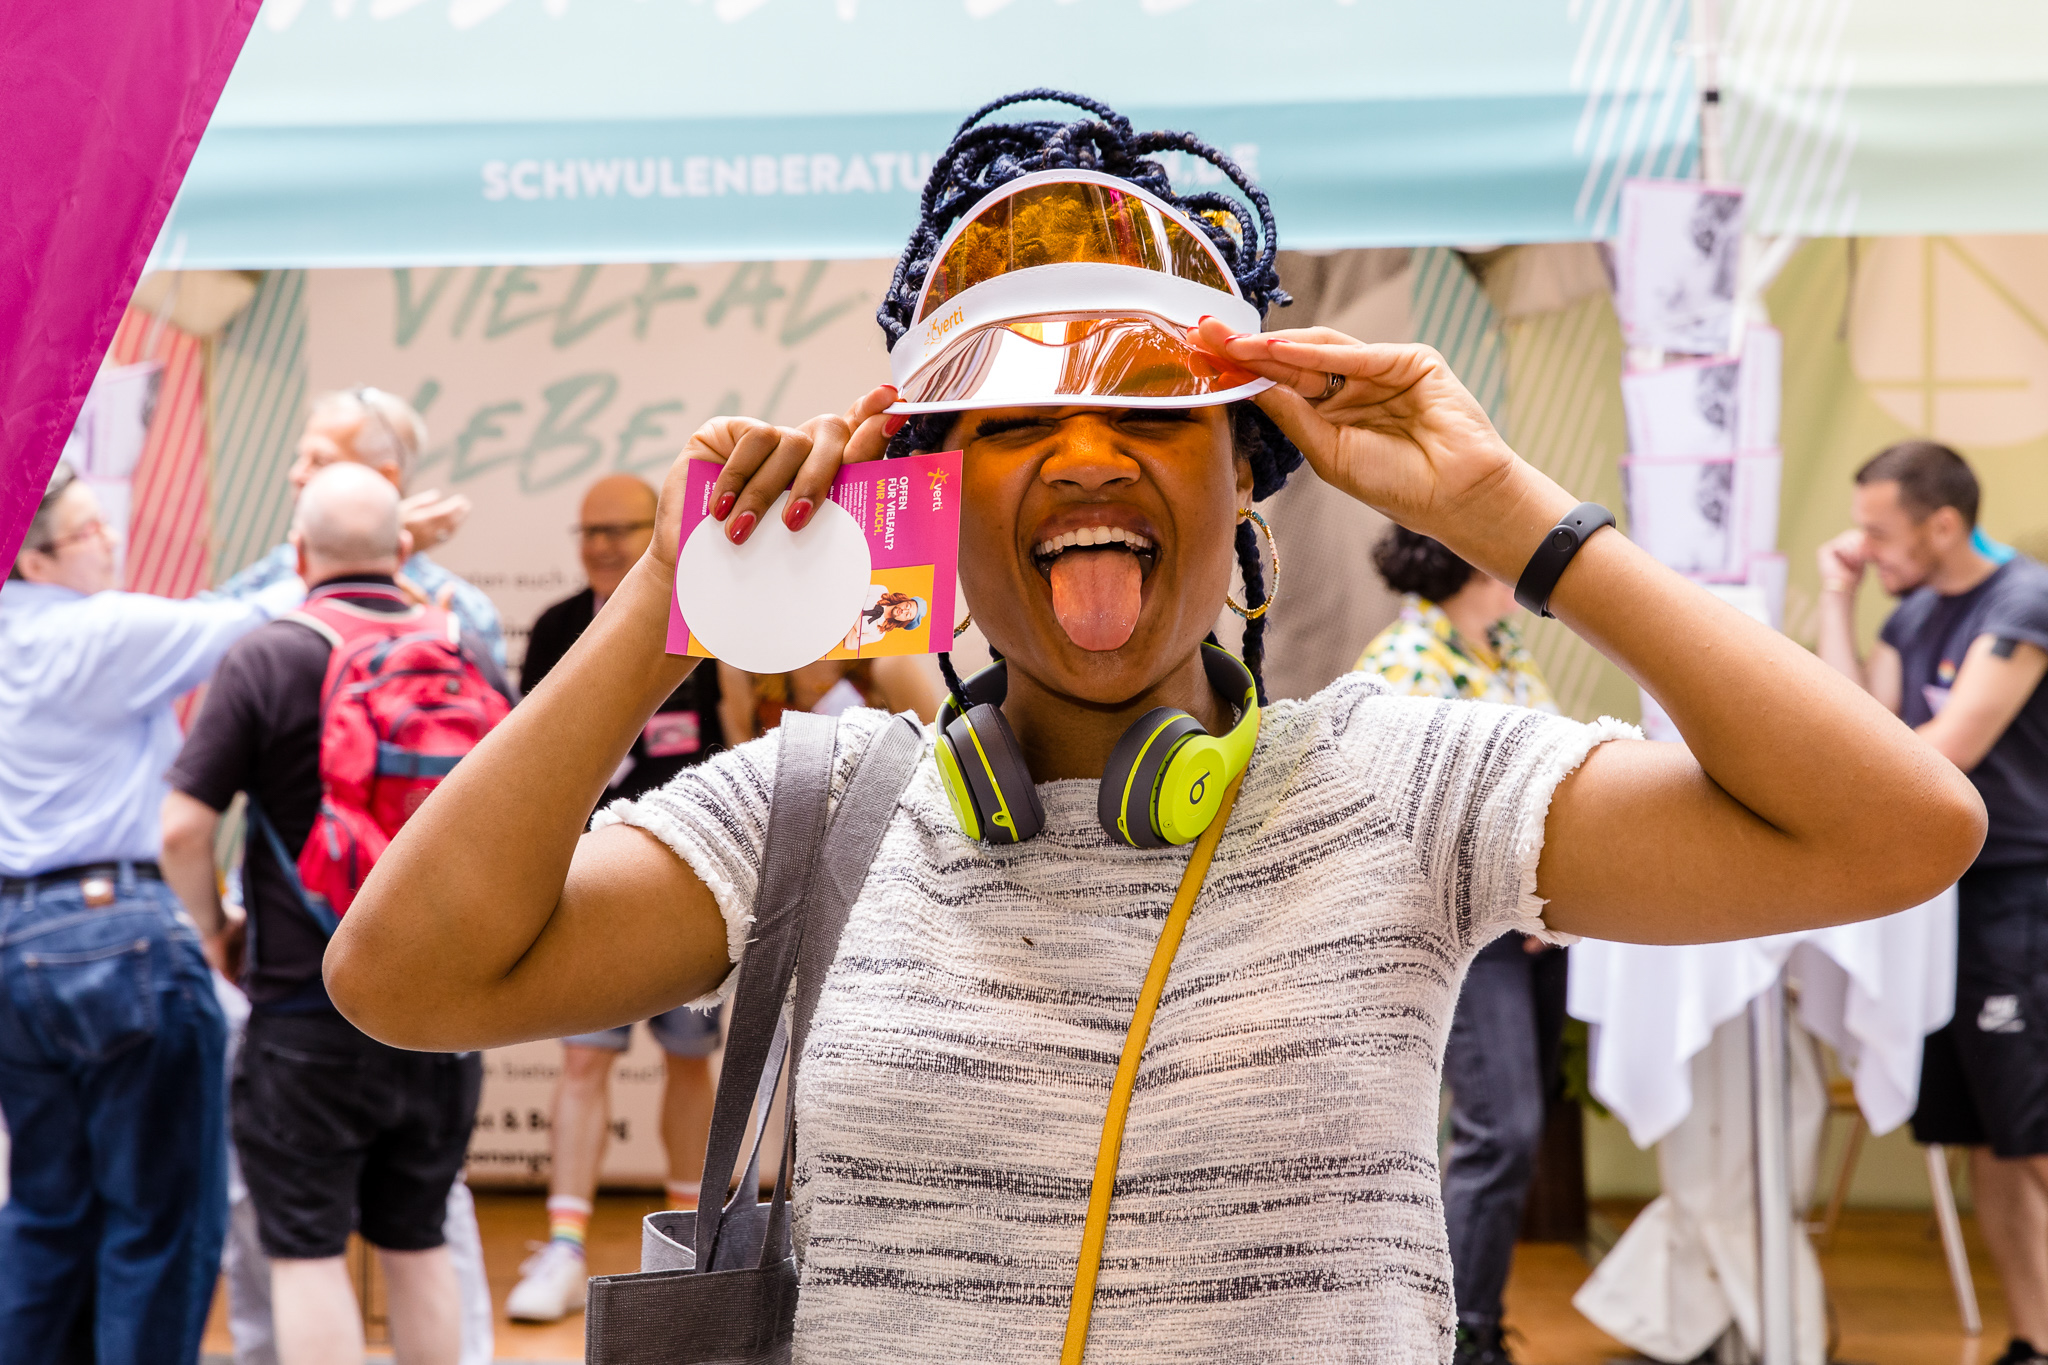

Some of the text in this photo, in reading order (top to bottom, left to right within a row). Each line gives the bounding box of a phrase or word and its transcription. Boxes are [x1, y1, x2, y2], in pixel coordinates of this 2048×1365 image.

[482, 151, 938, 201] SCHWULENBERATU
[391, 262, 870, 347] VIELFAL
[936, 305, 965, 336] verti
[873, 478, 886, 536] WIR AUCH.
[884, 477, 899, 551] FÜR VIELFALT?
[898, 476, 909, 511] OFFEN
[932, 482, 944, 512] verti
